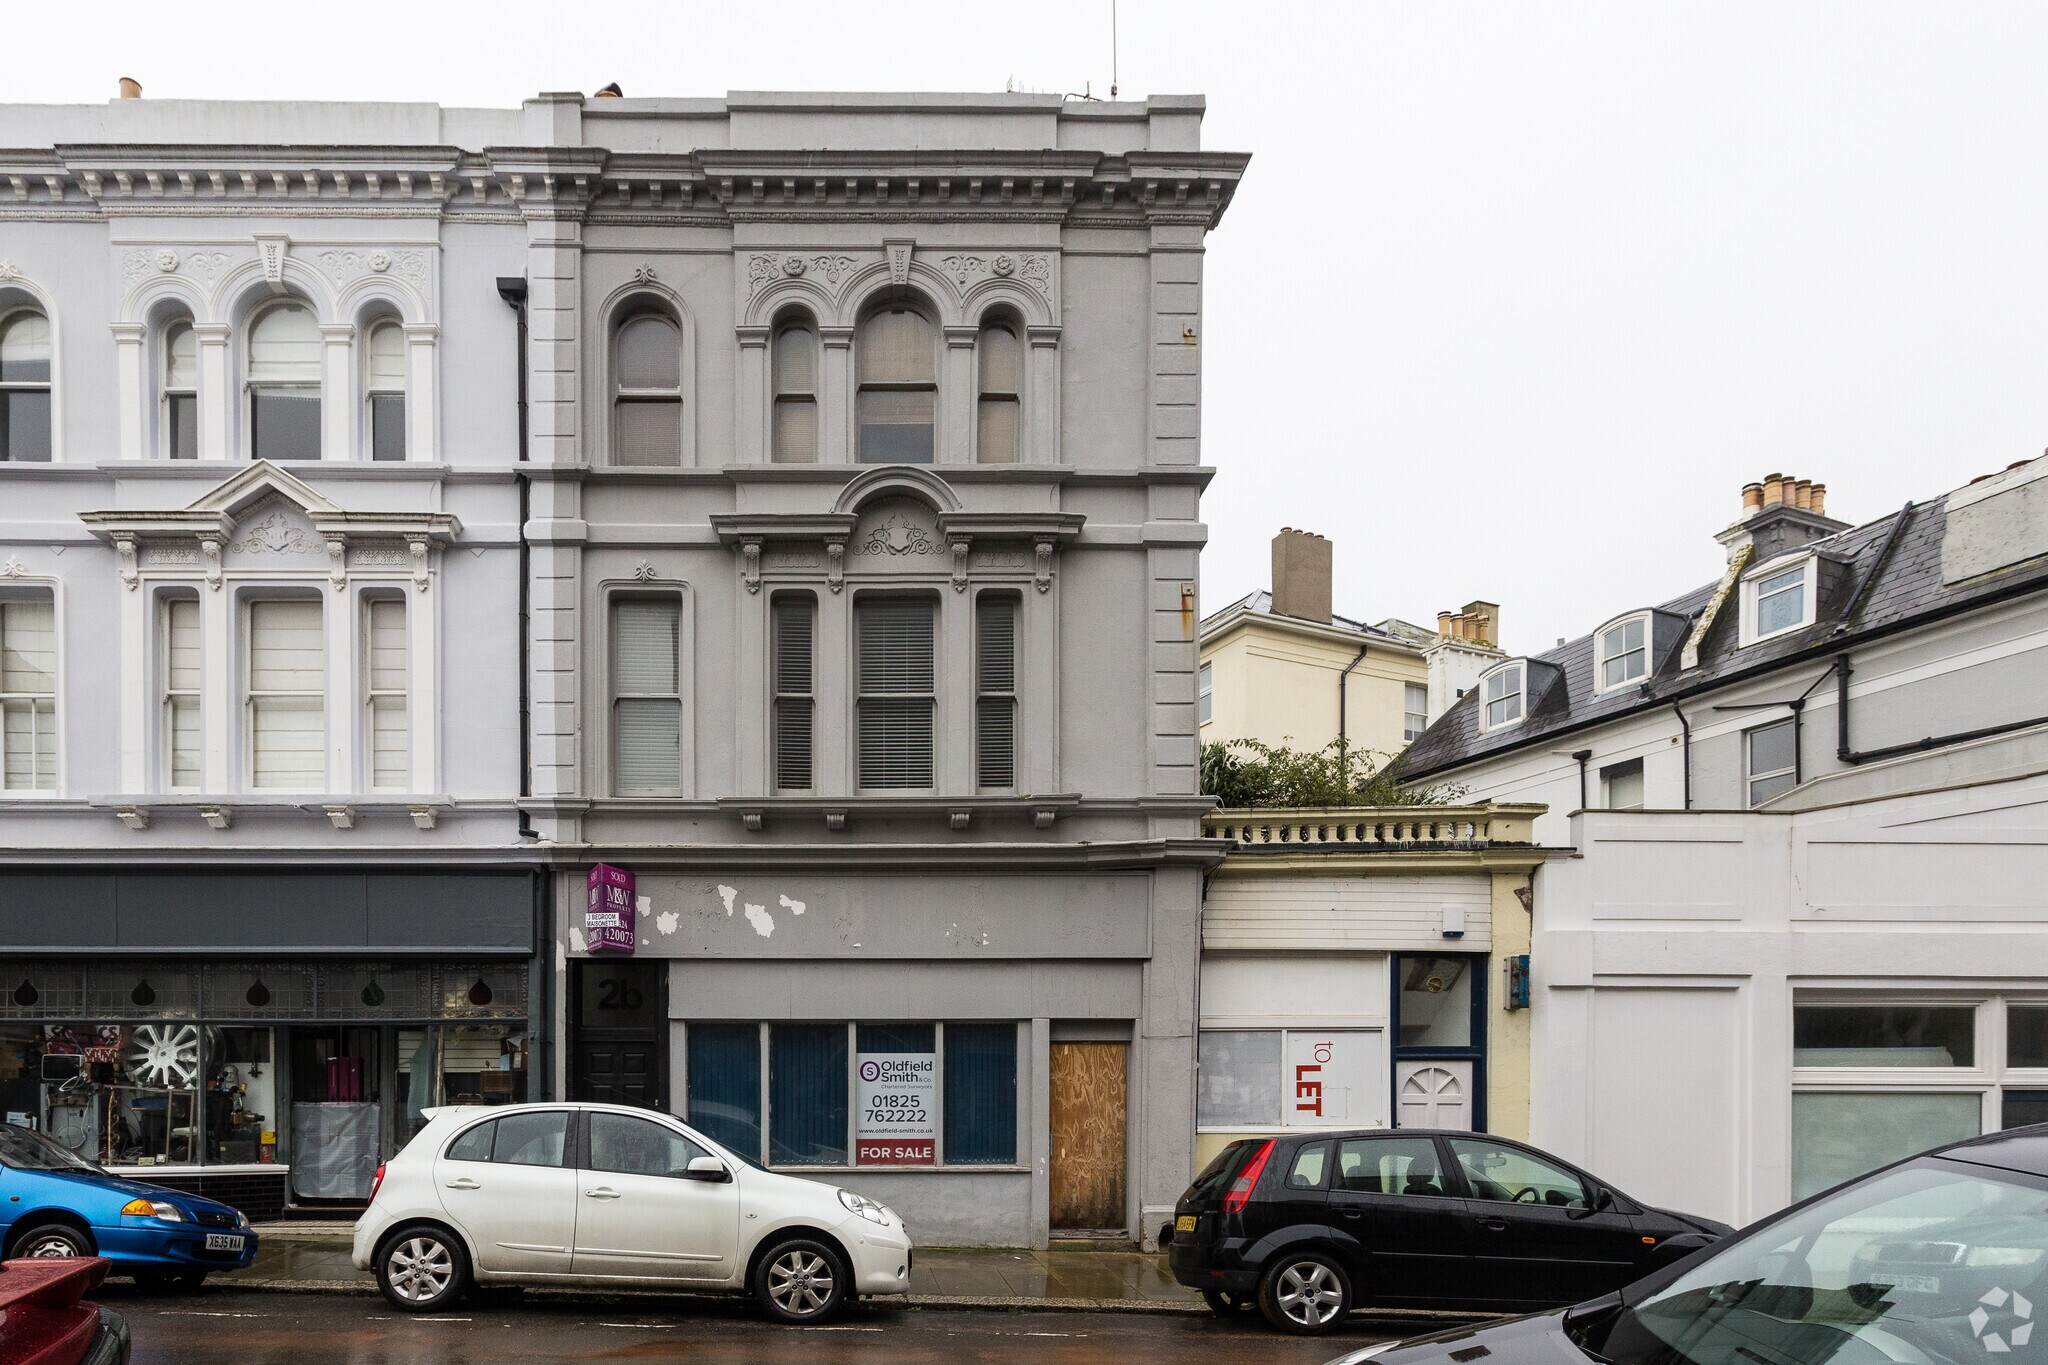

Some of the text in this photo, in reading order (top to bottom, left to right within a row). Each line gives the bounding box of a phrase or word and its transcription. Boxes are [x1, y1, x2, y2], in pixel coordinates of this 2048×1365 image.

[610, 870, 626, 883] SOLD
[606, 884, 631, 907] M&W
[606, 902, 631, 913] PROPERTY
[604, 927, 634, 945] 420073
[598, 979, 643, 1010] 2b
[881, 1061, 932, 1071] Oldfield
[881, 1072, 918, 1082] Smith
[1296, 1041, 1334, 1117] to LET
[872, 1095, 920, 1108] 01825
[865, 1109, 926, 1122] 762222
[860, 1147, 932, 1158] FOR SALE
[208, 1235, 228, 1248] X635
